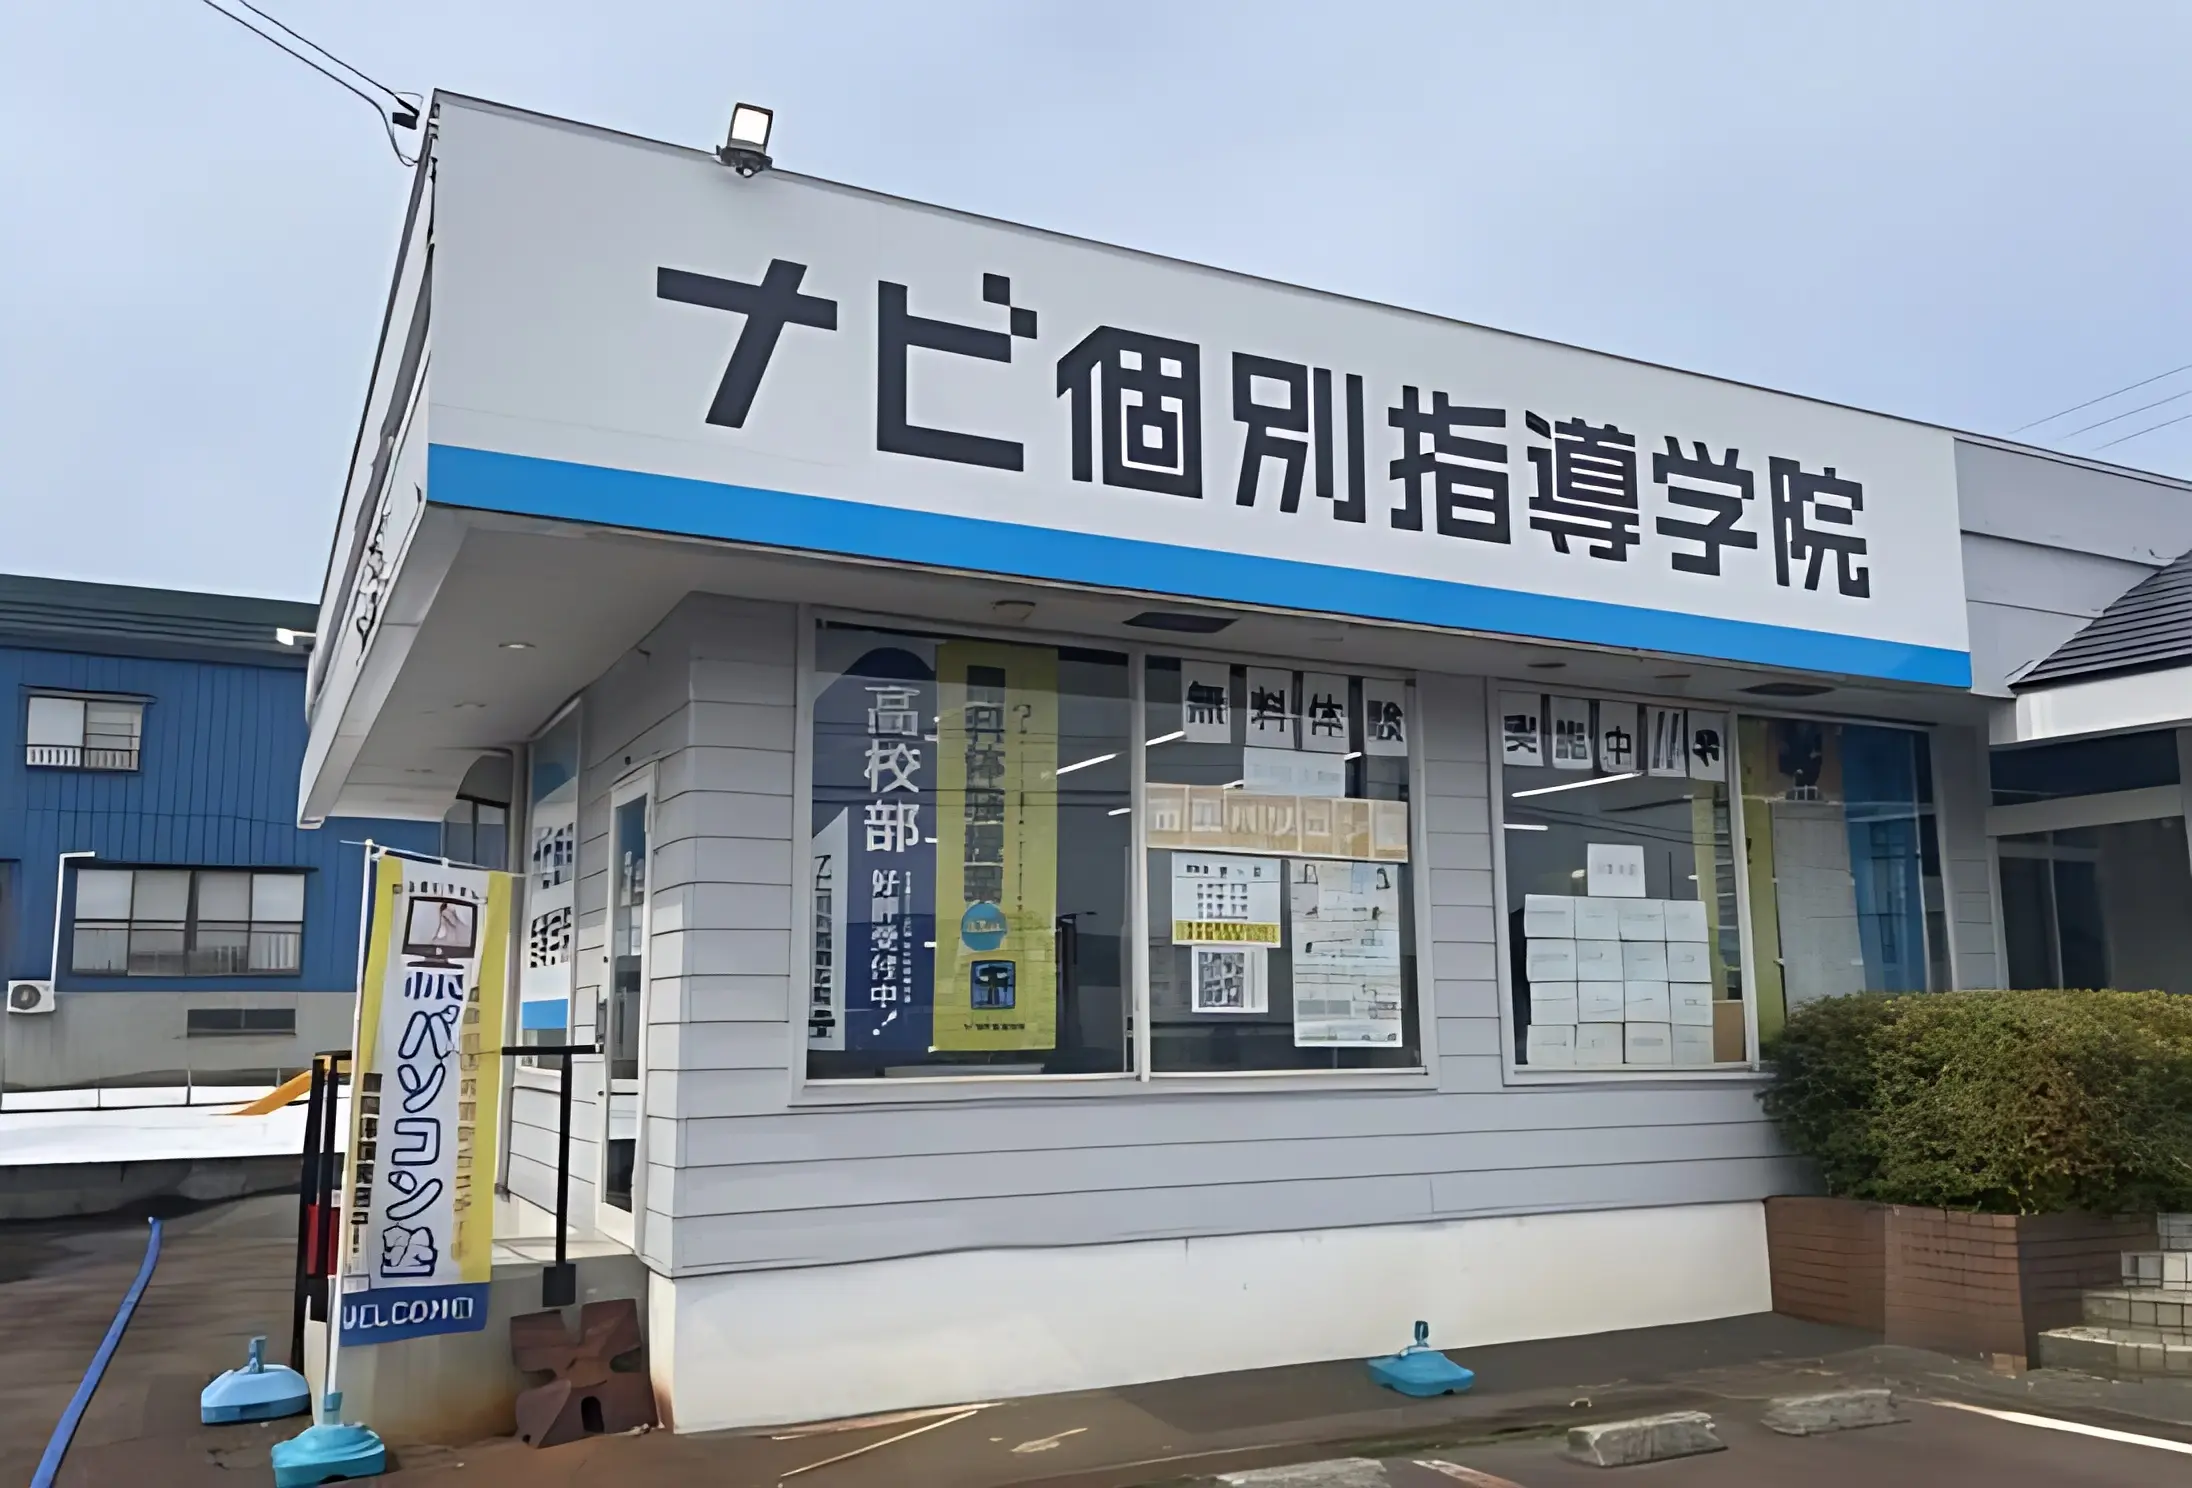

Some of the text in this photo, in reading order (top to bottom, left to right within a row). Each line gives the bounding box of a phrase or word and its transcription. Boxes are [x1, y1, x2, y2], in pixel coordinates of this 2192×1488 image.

[657, 258, 1869, 598] ナビ個別指導学院
[864, 686, 921, 852] 高校部
